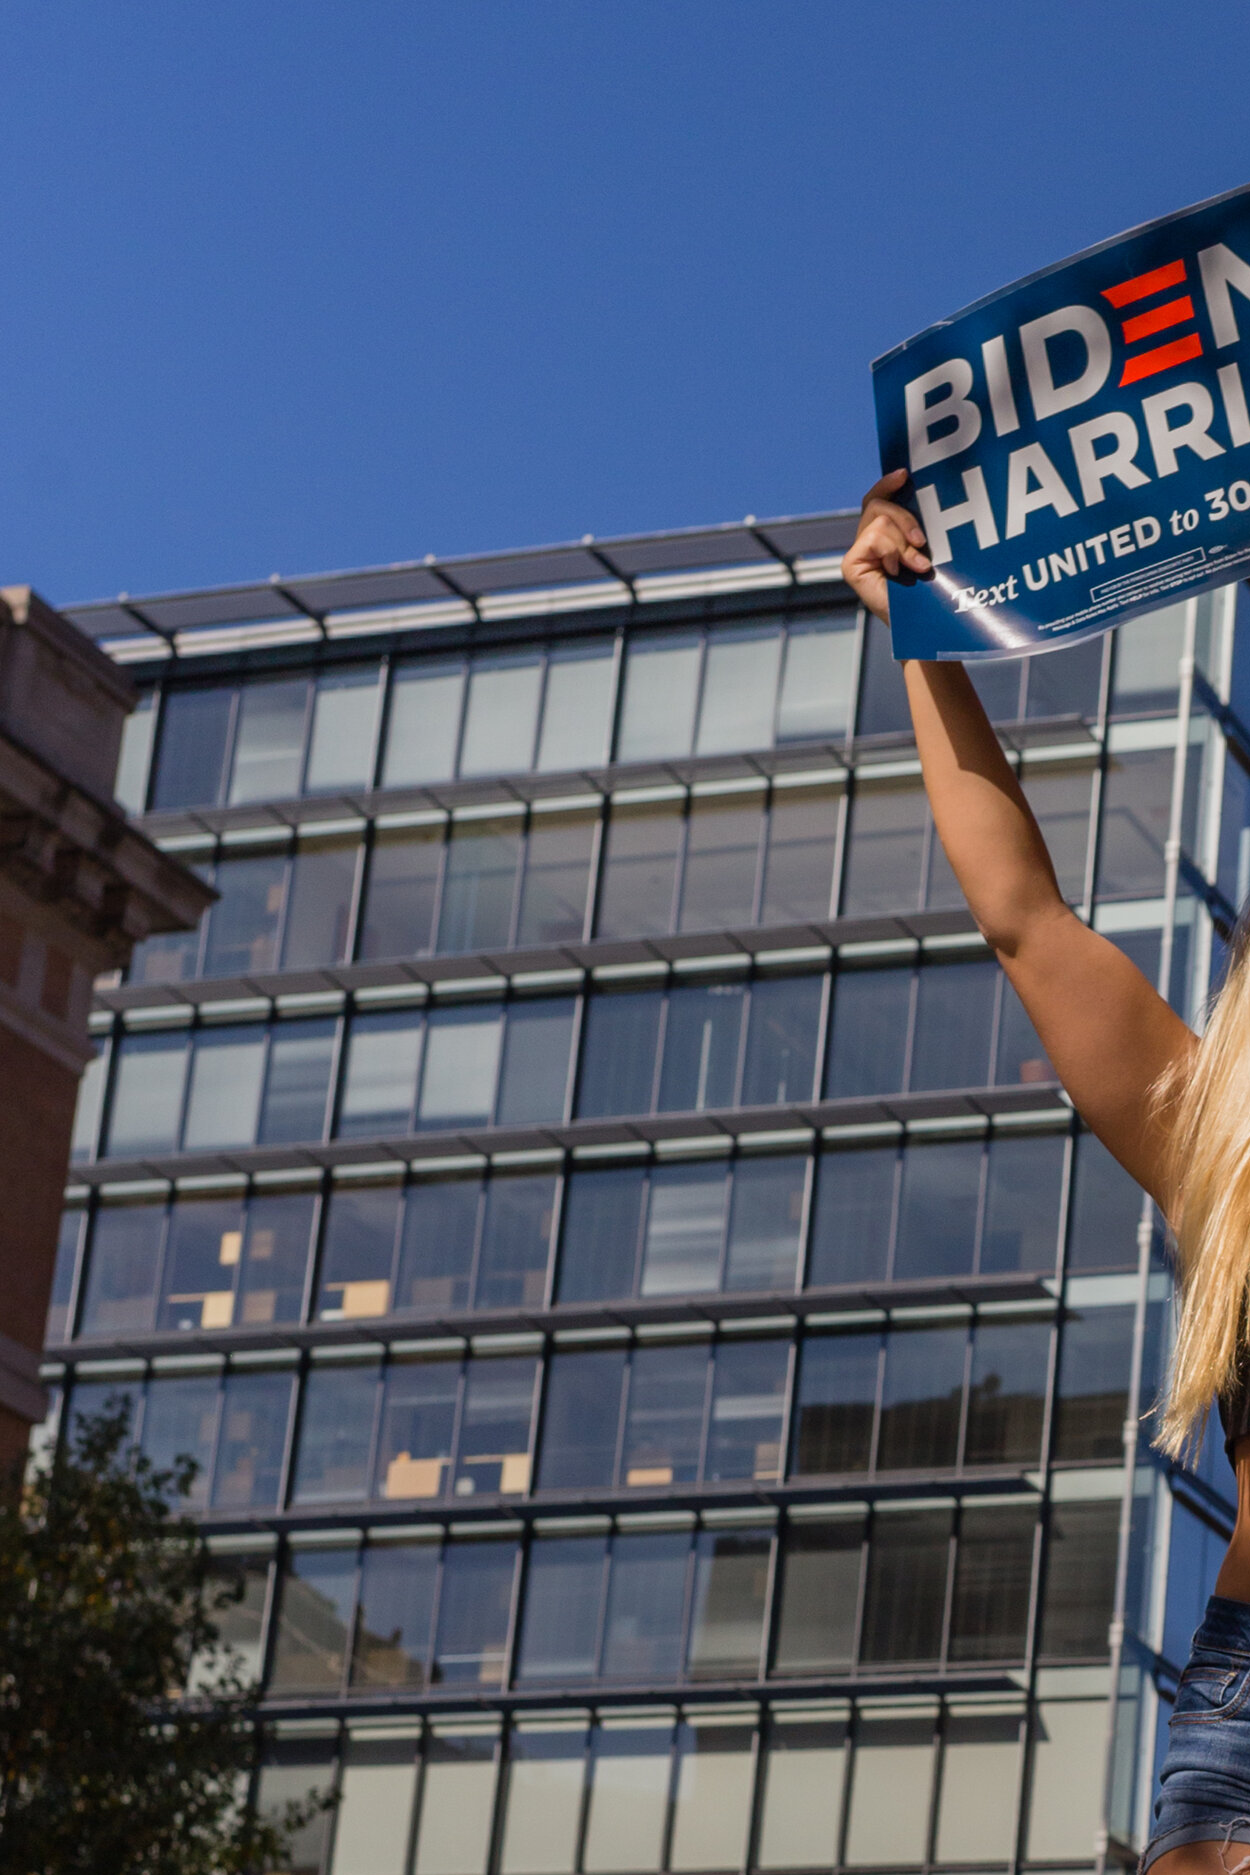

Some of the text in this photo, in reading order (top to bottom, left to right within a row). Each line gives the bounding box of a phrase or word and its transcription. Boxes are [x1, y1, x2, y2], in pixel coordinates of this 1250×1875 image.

[952, 574, 1020, 614] Text
[1023, 516, 1162, 592] UNITED
[1170, 508, 1199, 533] to
